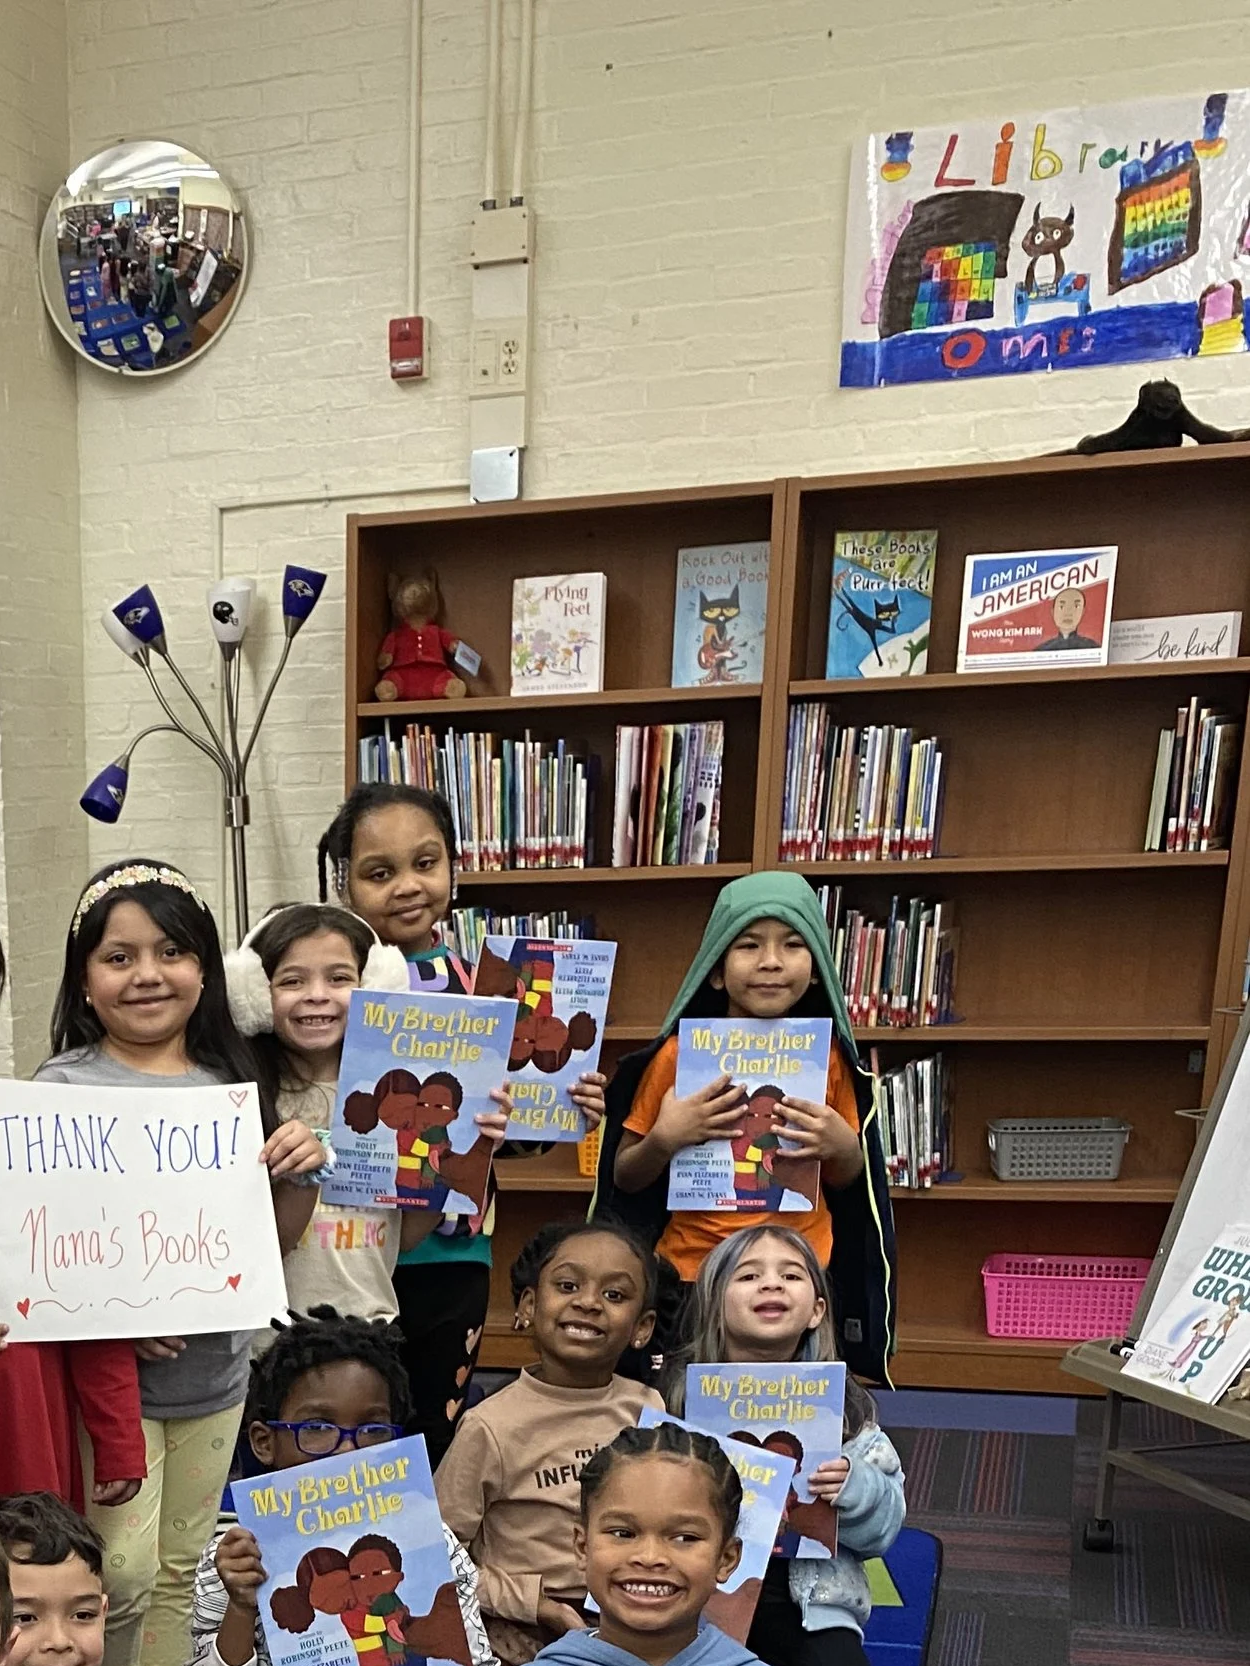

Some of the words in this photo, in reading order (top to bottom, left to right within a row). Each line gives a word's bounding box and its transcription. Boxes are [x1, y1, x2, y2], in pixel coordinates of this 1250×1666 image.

[842, 540, 883, 556] These
[889, 539, 931, 554] Books
[695, 569, 732, 585] Good
[873, 558, 895, 571] are
[982, 577, 987, 591] I
[990, 569, 1013, 589] AM
[1015, 560, 1038, 579] AN
[545, 586, 588, 603] Flying
[974, 559, 1099, 617] AMERICAN
[563, 602, 591, 617] Feet
[971, 628, 1003, 639] WONG
[1004, 627, 1023, 637] KIM
[1184, 624, 1228, 658] kind
[366, 1004, 399, 1034] My
[404, 1008, 499, 1037] Brother
[392, 1037, 482, 1065] Charlie
[694, 1030, 723, 1054] My
[729, 1031, 814, 1055] Brother
[721, 1056, 802, 1077] Charlie
[144, 1116, 240, 1173] YOU!
[21, 1204, 125, 1293] Nana's
[138, 1207, 231, 1282] Books
[1179, 1361, 1203, 1383] P
[702, 1377, 733, 1401] My
[739, 1376, 829, 1401] Brother
[731, 1397, 816, 1423] Charlie
[252, 1488, 293, 1517] My
[298, 1460, 409, 1506] Brother
[297, 1491, 403, 1536] Charlie
[280, 1647, 322, 1665] ROBINSON
[324, 1639, 349, 1653] PEETE
[300, 1636, 325, 1650] HOLLY
